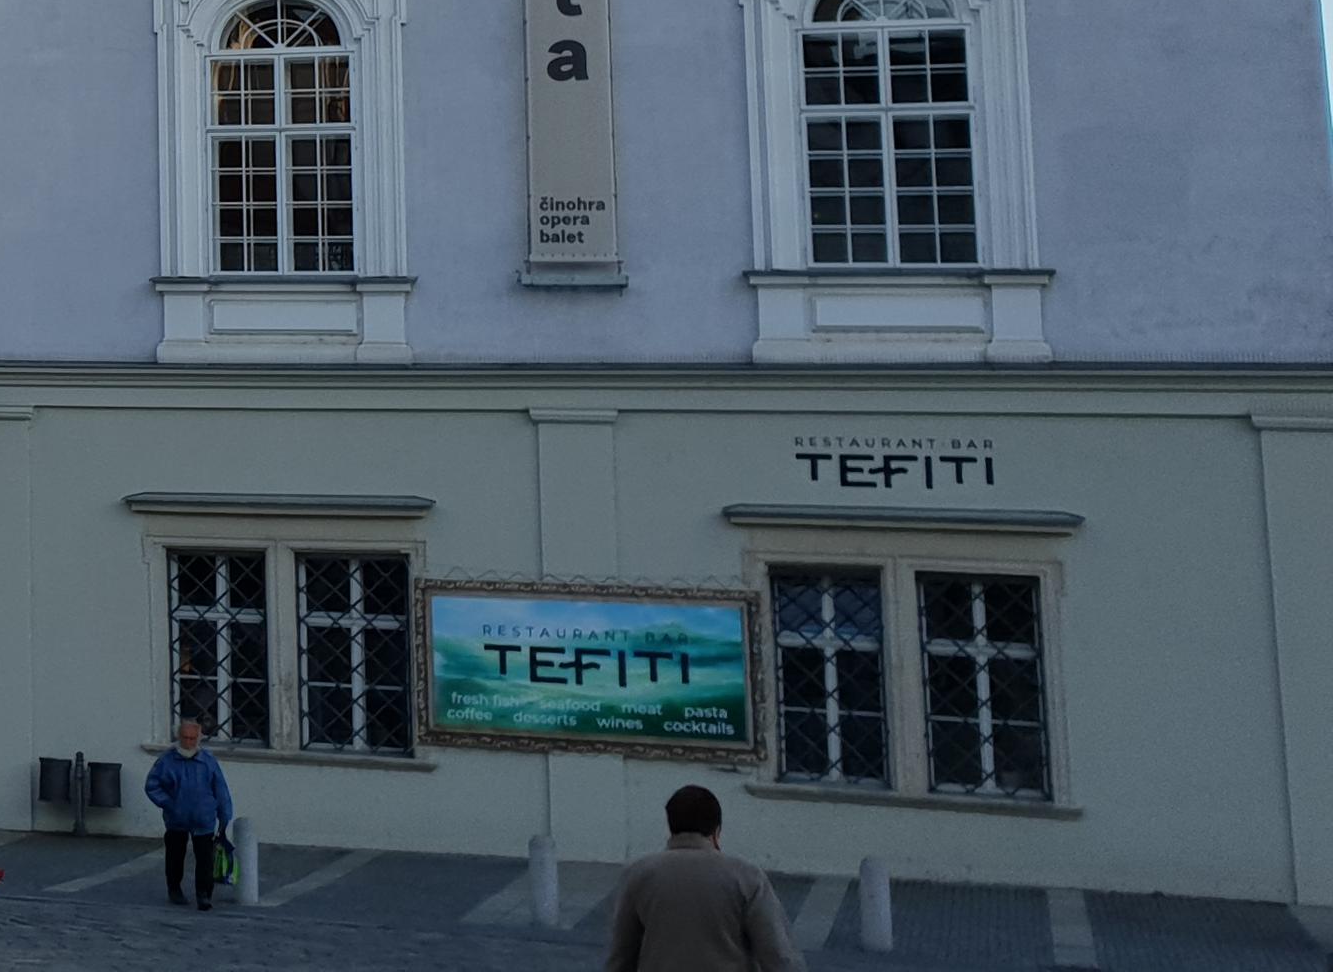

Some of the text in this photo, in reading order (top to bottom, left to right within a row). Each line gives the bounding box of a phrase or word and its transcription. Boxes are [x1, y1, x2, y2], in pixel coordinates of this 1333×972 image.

[539, 196, 606, 211] činohra
[539, 215, 590, 229] opera
[539, 229, 584, 244] balet
[794, 436, 993, 450] RESTAURANT BAR
[795, 453, 994, 490] TEFITI
[483, 624, 689, 645] RESTAURANT BAR
[484, 643, 690, 688] TEFITI
[451, 691, 488, 707] fresh
[540, 697, 601, 713] seafood
[621, 703, 664, 716] meat
[684, 705, 729, 722] pasta
[446, 707, 735, 736] coffee desserts wines cocktails
